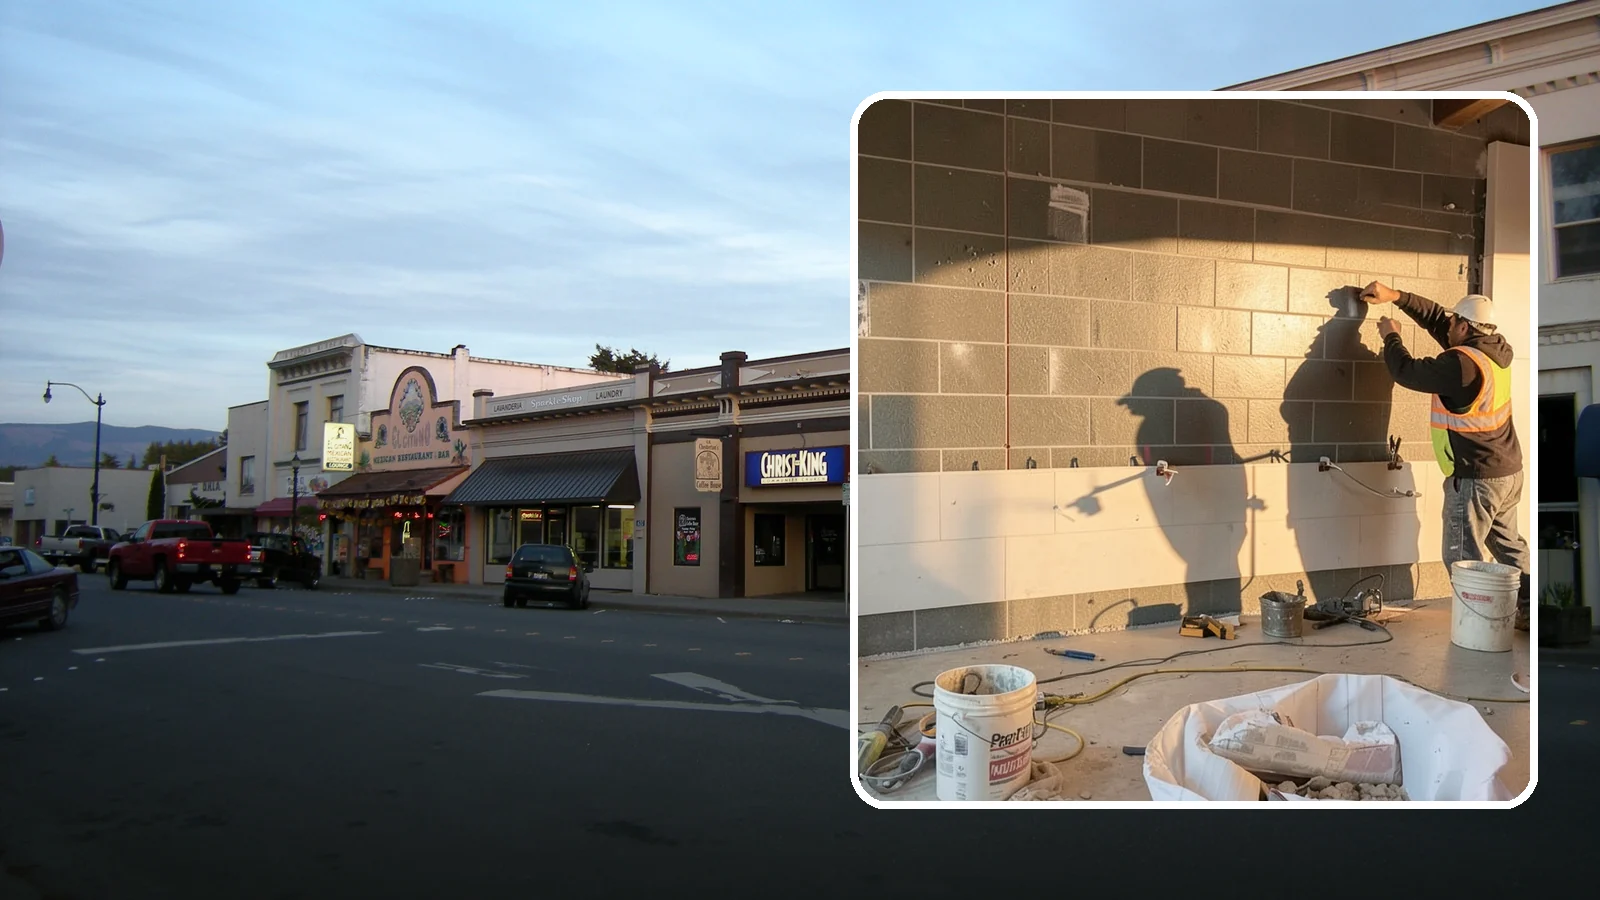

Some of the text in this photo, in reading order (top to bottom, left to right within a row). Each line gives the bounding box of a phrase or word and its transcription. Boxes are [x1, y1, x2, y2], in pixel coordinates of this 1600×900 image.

[531, 394, 583, 409] Sparkle Shop
[595, 389, 623, 400] LAUNDRY
[493, 402, 522, 412] LAVANDERIA
[373, 455, 397, 464] MEXICAN
[397, 451, 433, 462] RESTAURANT
[437, 450, 450, 459] BAR
[760, 450, 827, 478] CHRIST KING
